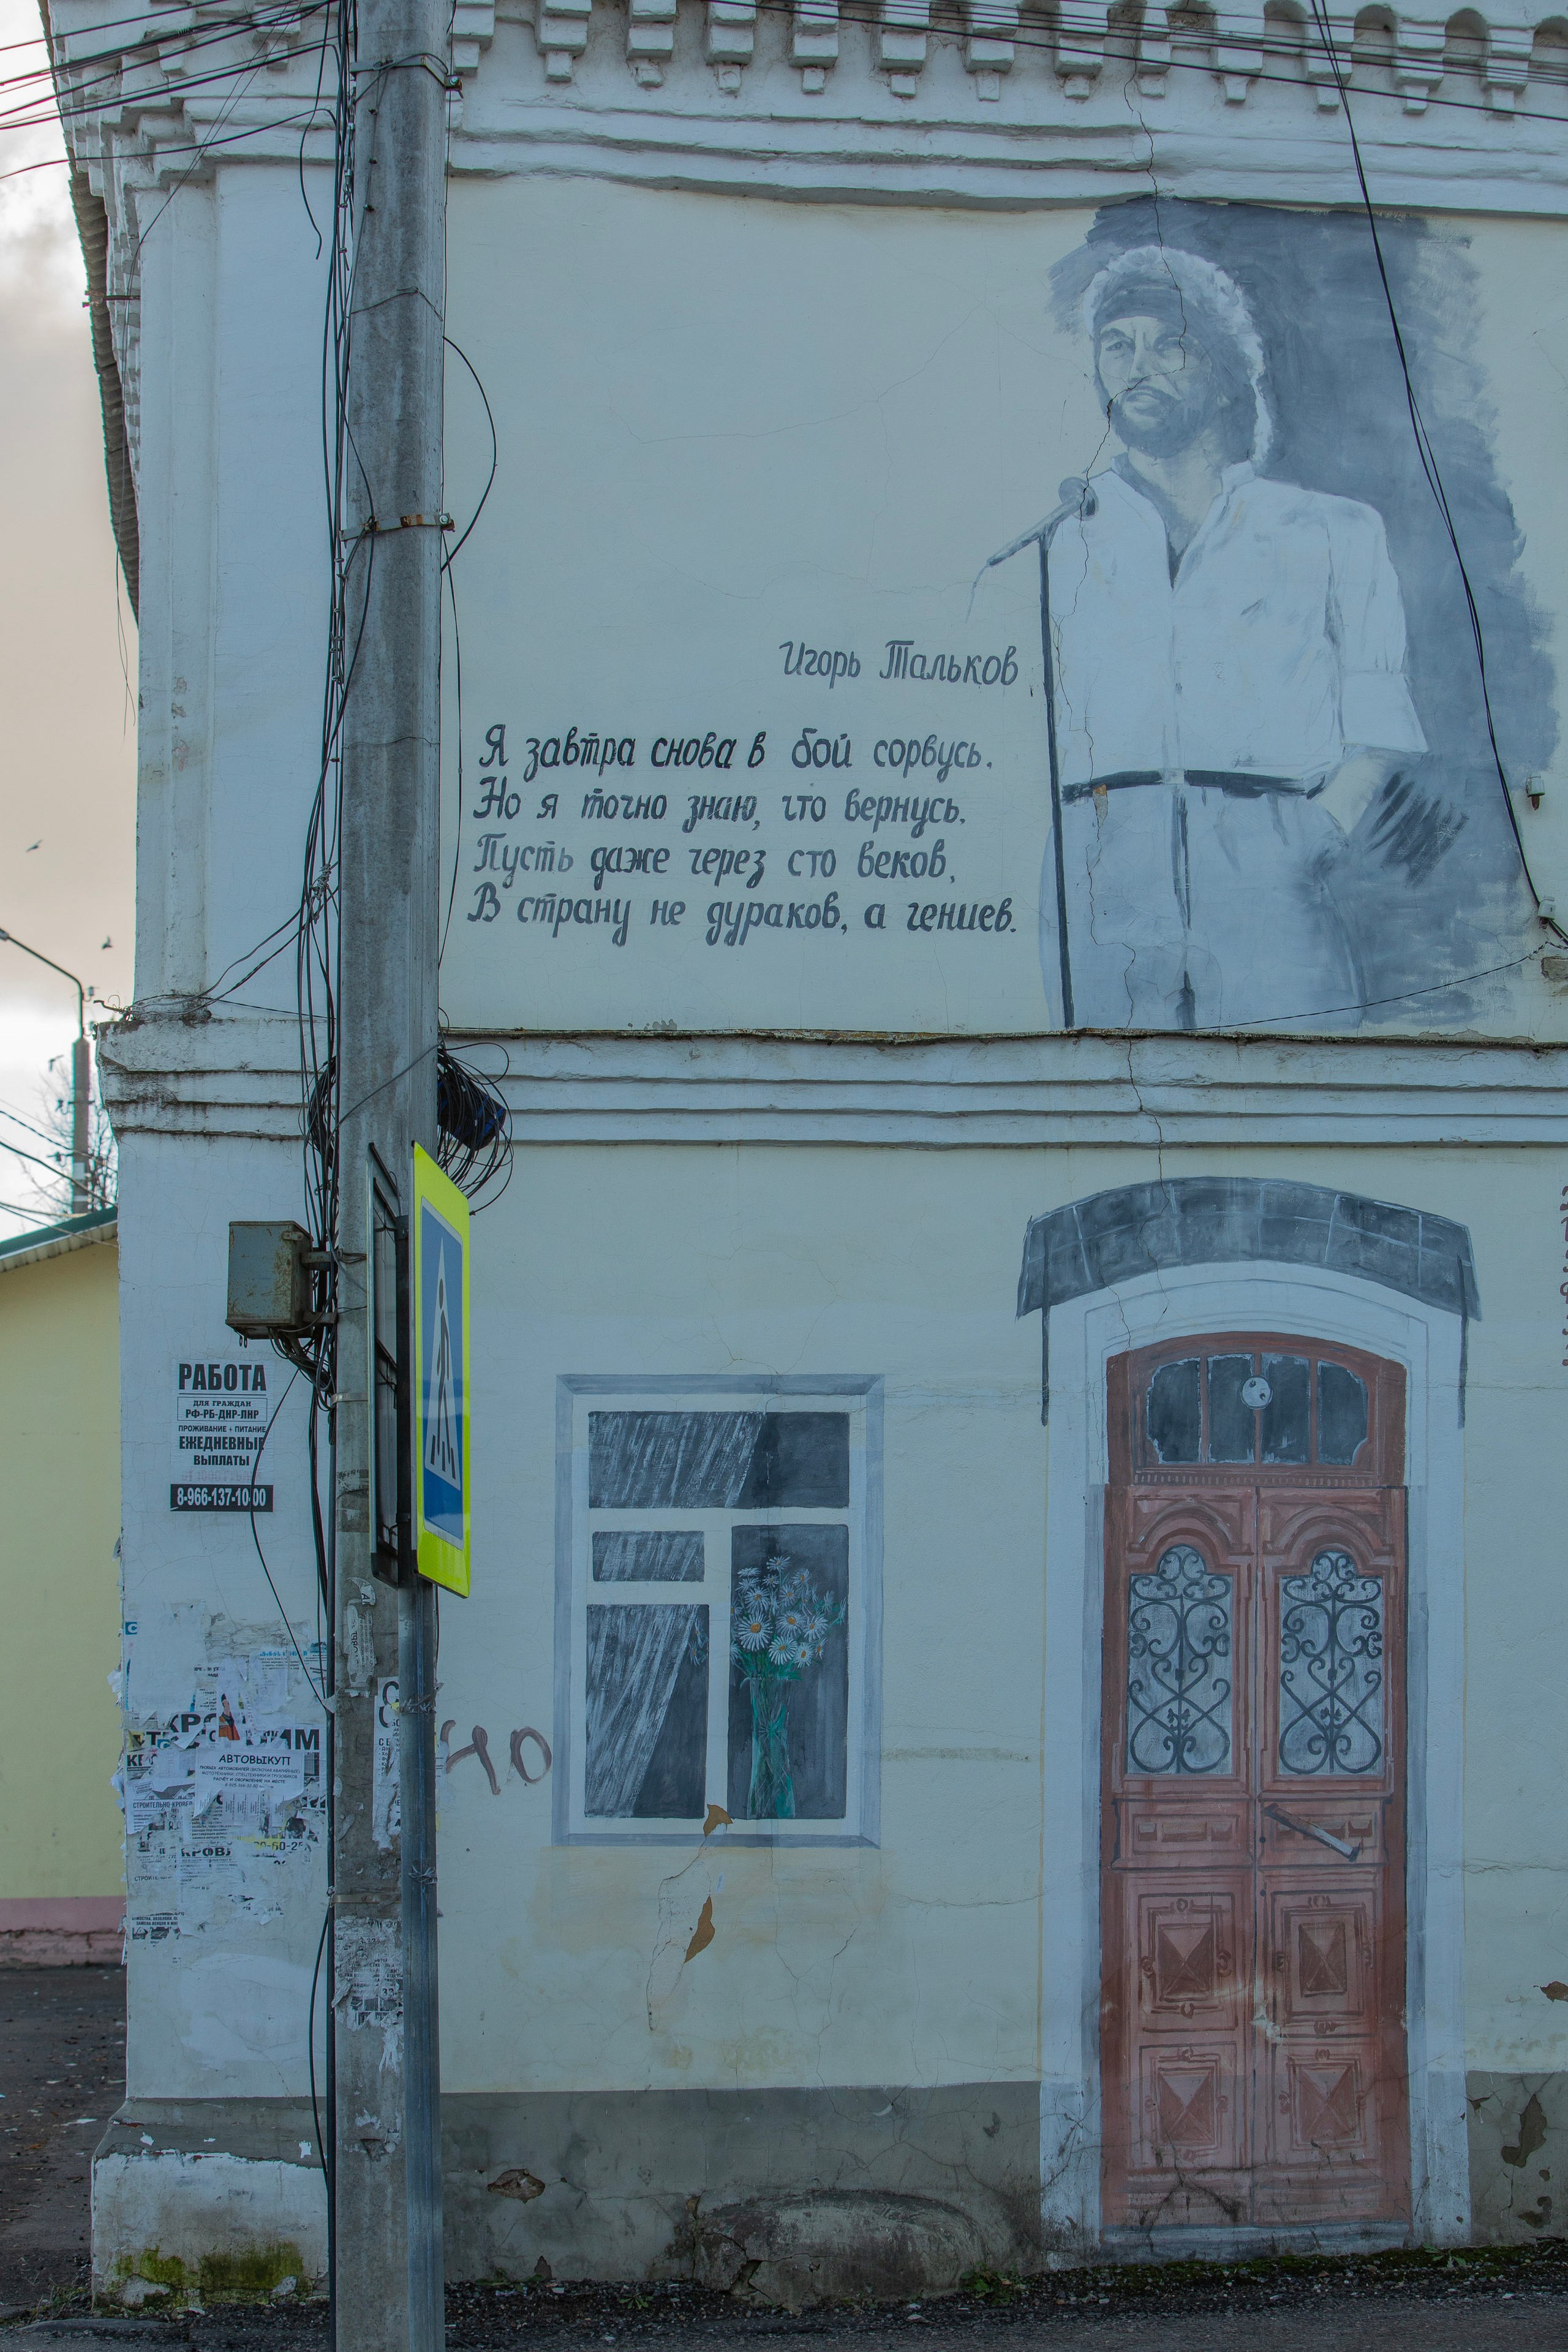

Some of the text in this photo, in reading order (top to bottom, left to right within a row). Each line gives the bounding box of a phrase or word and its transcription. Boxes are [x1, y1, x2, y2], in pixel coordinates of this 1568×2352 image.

[779, 640, 1018, 689] Игорь Тальков
[479, 724, 509, 767] Я
[524, 726, 636, 783] завтра
[651, 732, 737, 769] снова
[747, 731, 766, 768] в
[792, 728, 853, 768] бой
[473, 775, 521, 820] Но
[537, 794, 559, 819] я
[581, 788, 667, 820] точно
[682, 795, 760, 833] знаю,
[782, 796, 826, 822] что
[473, 833, 956, 891] Пусть даже через сто веков,
[467, 882, 1016, 948] В страну не дураков, а гениев.
[179, 1363, 266, 1391] РАБОТА
[186, 1409, 259, 1420] РФ-РБ-ДНР-ЛНР
[179, 1436, 265, 1452] ЕЖЕДНЕВНЫЕ
[194, 1455, 250, 1466] ВЫПЛАТЫ
[219, 1754, 291, 1765] АВТОВЫКУП
